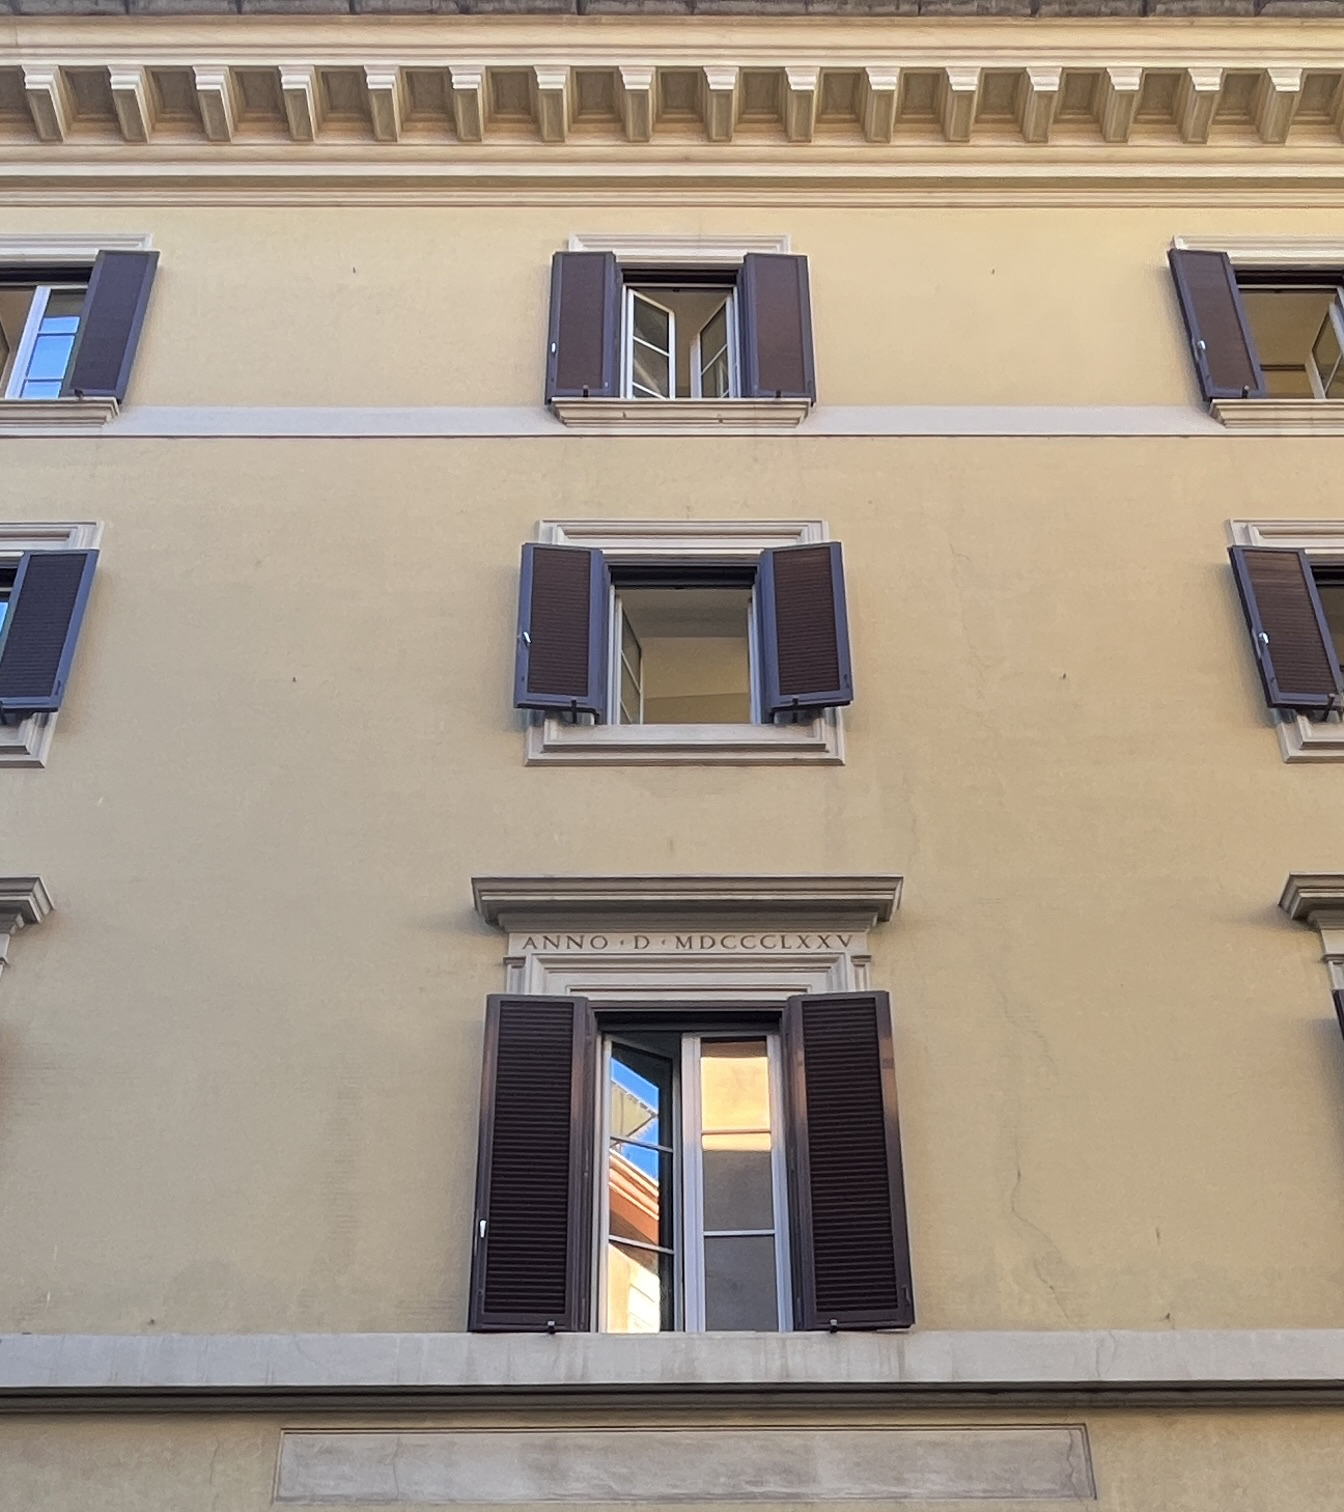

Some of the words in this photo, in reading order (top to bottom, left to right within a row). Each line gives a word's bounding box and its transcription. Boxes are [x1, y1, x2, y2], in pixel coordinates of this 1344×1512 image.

[522, 935, 609, 950] ANNO
[634, 935, 651, 950] D
[675, 934, 854, 950] MDCCCLXXV
